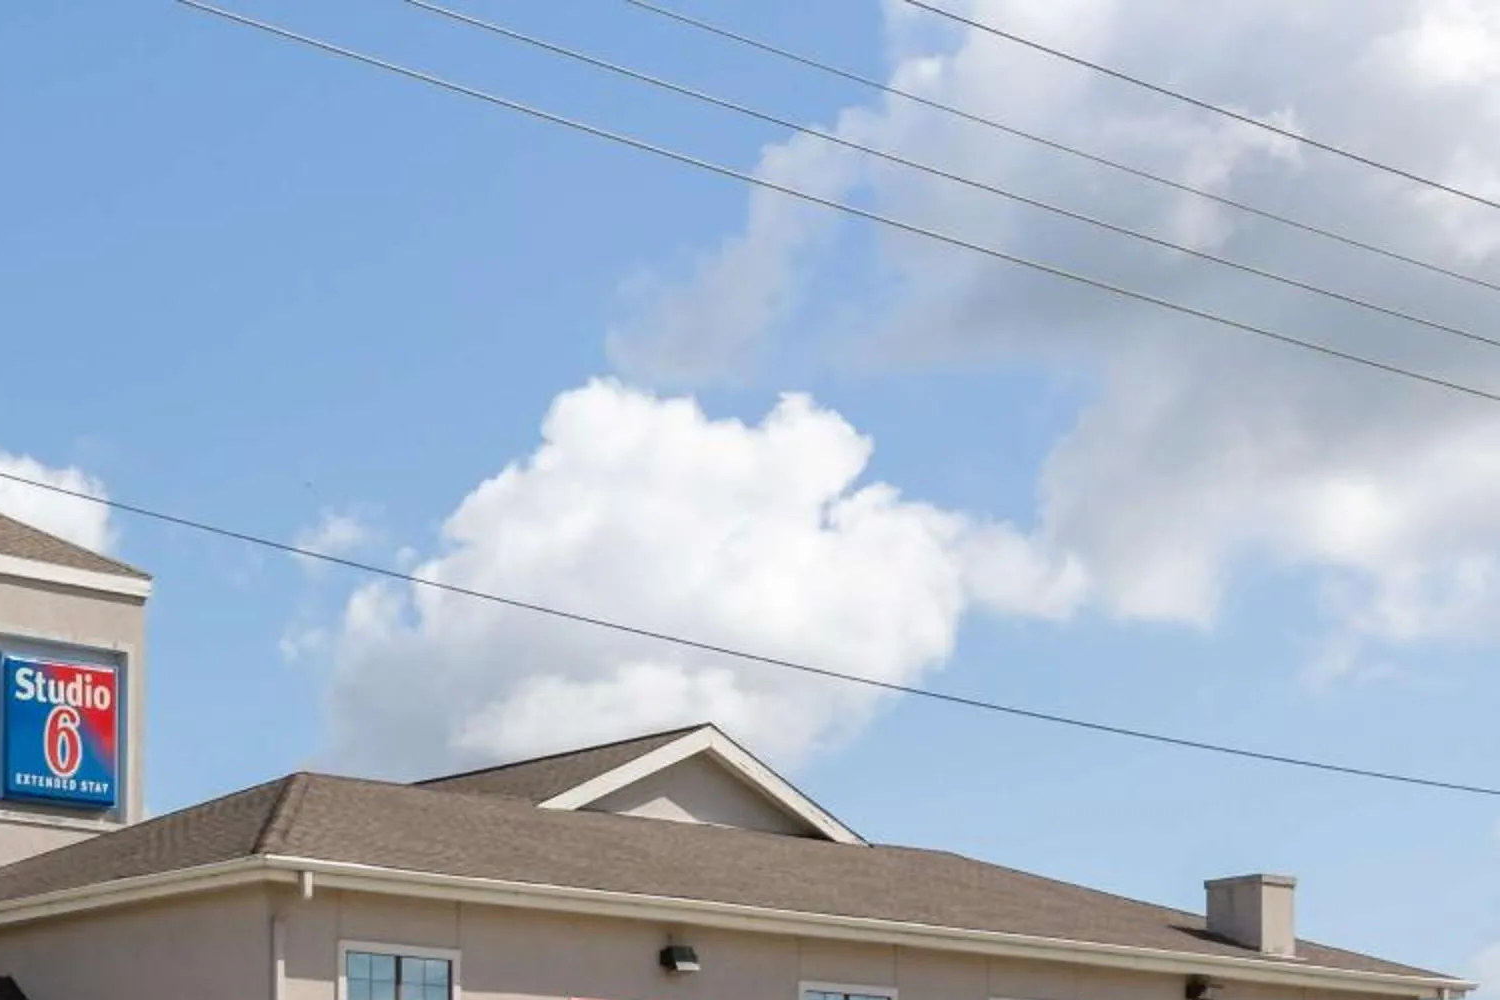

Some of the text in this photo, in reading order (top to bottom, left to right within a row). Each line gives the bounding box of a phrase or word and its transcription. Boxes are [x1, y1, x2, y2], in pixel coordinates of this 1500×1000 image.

[15, 667, 111, 711] Studio
[44, 705, 83, 778] 6
[15, 772, 109, 795] EXTENDED STAY
